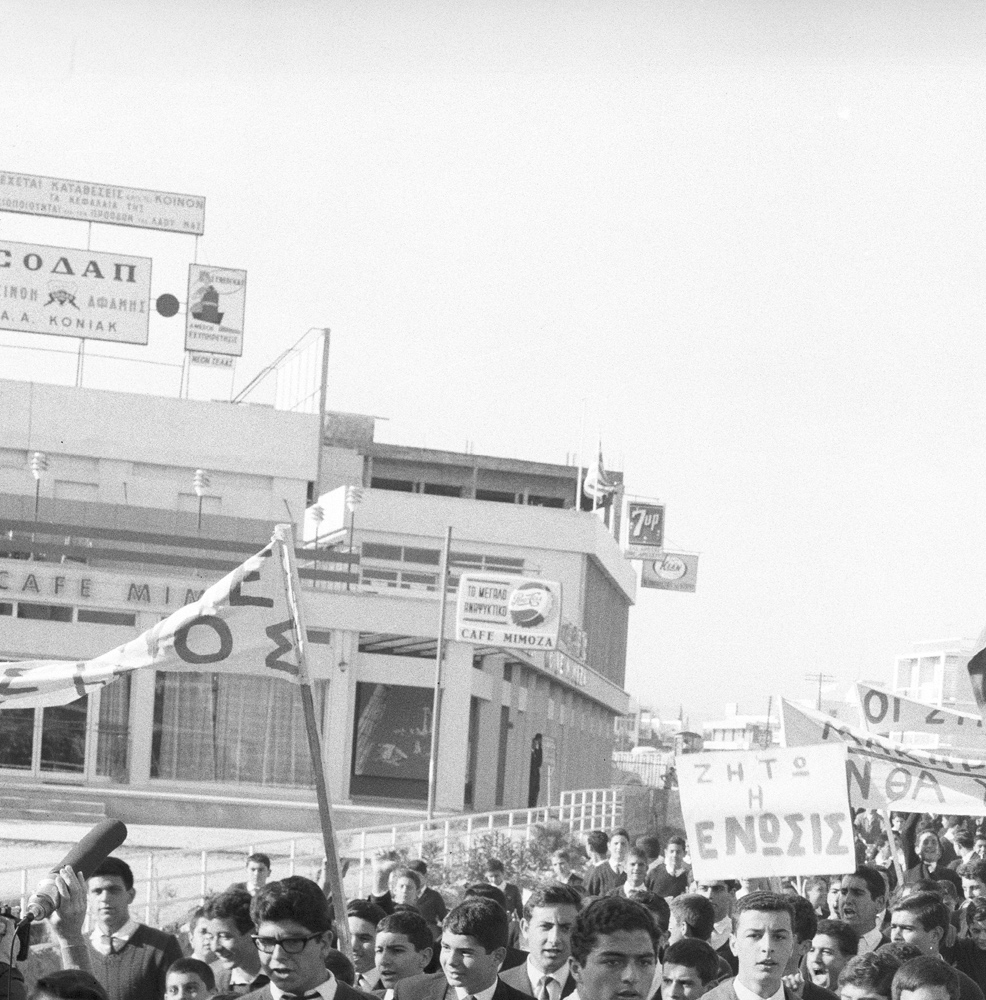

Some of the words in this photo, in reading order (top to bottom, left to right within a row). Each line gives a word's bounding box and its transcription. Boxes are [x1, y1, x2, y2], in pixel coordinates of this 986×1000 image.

[49, 315, 118, 333] ΚΟΝΙΑΚ
[461, 628, 495, 642] CAFE
[503, 632, 554, 648] MIMOZA
[694, 756, 811, 784] ΖΗΤΩ
[748, 784, 764, 810] Η
[694, 812, 850, 860] ΕΝΩΣΙΣ
